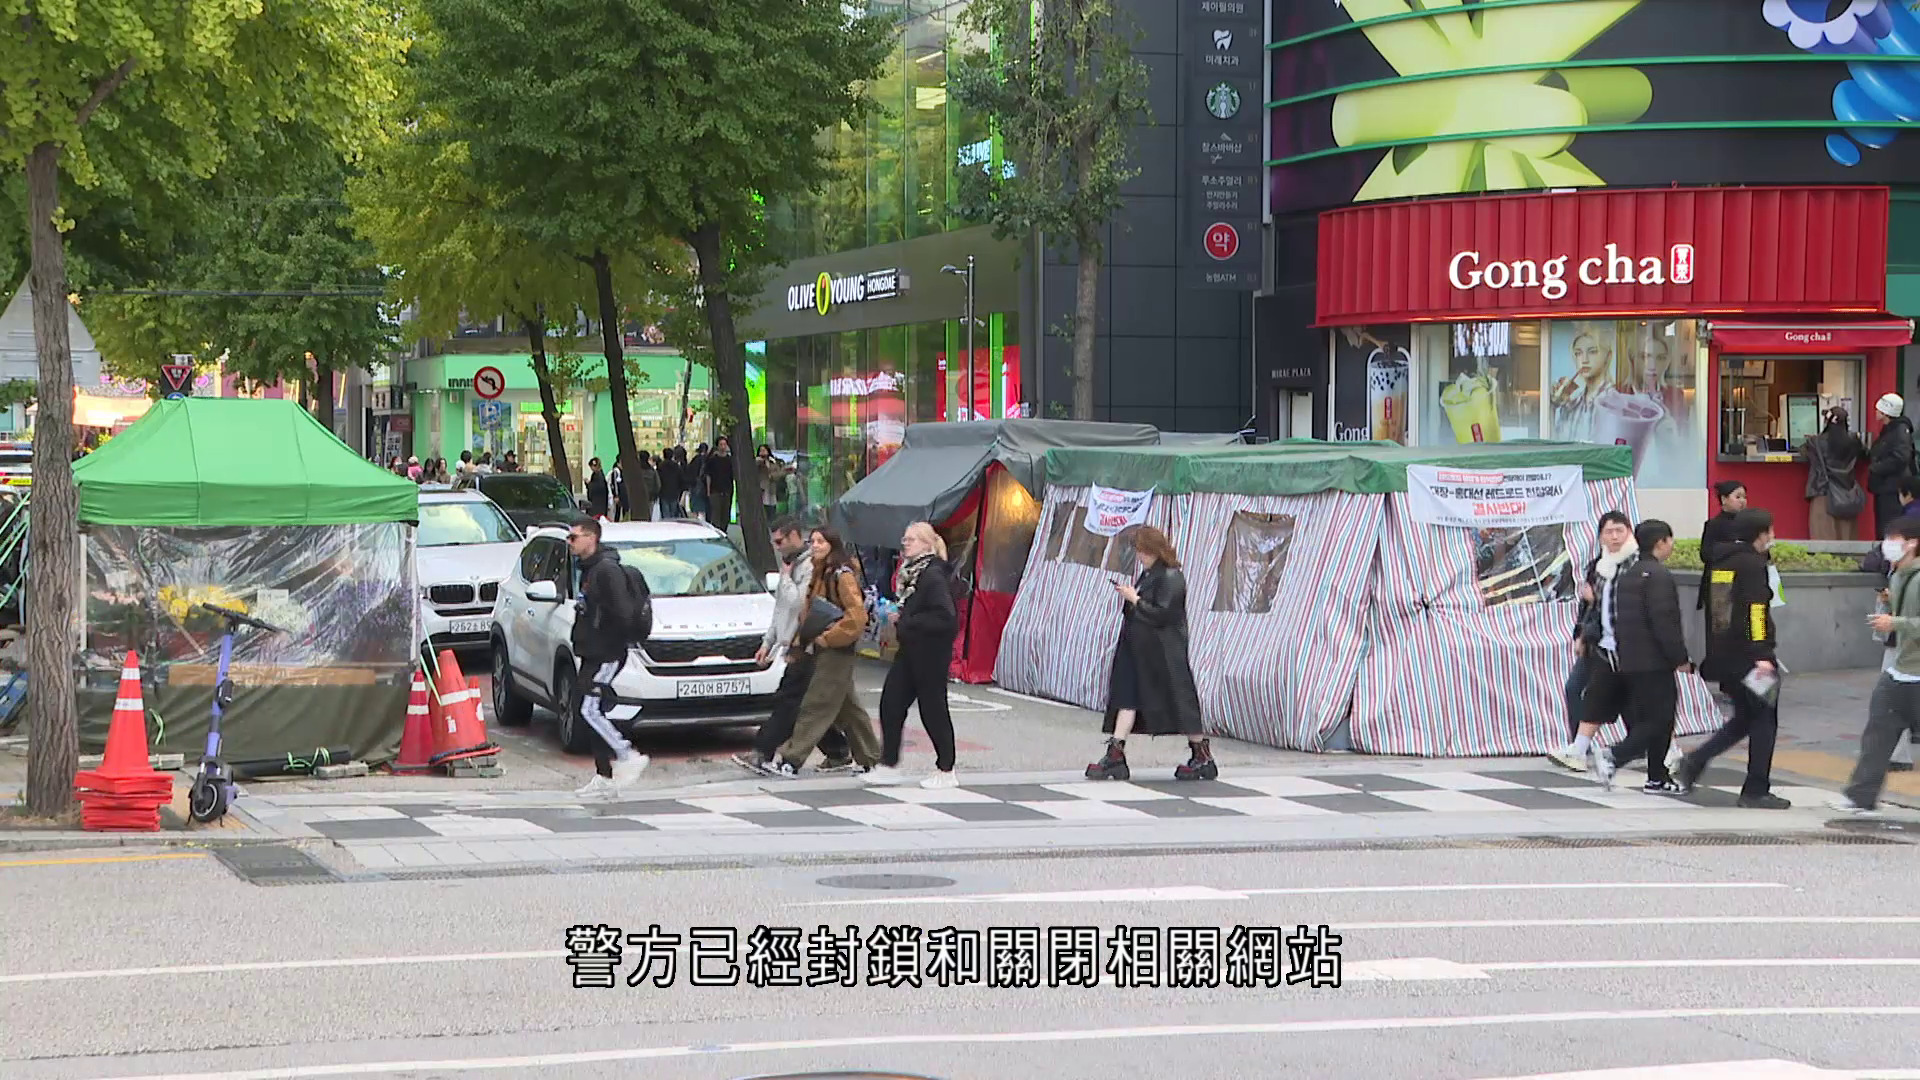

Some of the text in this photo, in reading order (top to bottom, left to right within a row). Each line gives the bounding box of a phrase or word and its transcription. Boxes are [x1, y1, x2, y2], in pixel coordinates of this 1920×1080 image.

[1205, 54, 1239, 66] 미래치과
[1212, 231, 1231, 252] 약
[1449, 243, 1665, 300] Gong cha
[787, 273, 897, 312] OLIVE YOUNG HONGDAE
[1785, 331, 1809, 344] Gong
[1810, 331, 1826, 341] cha
[1292, 367, 1311, 378] PLAZA
[1485, 486, 1524, 500] 레드로드
